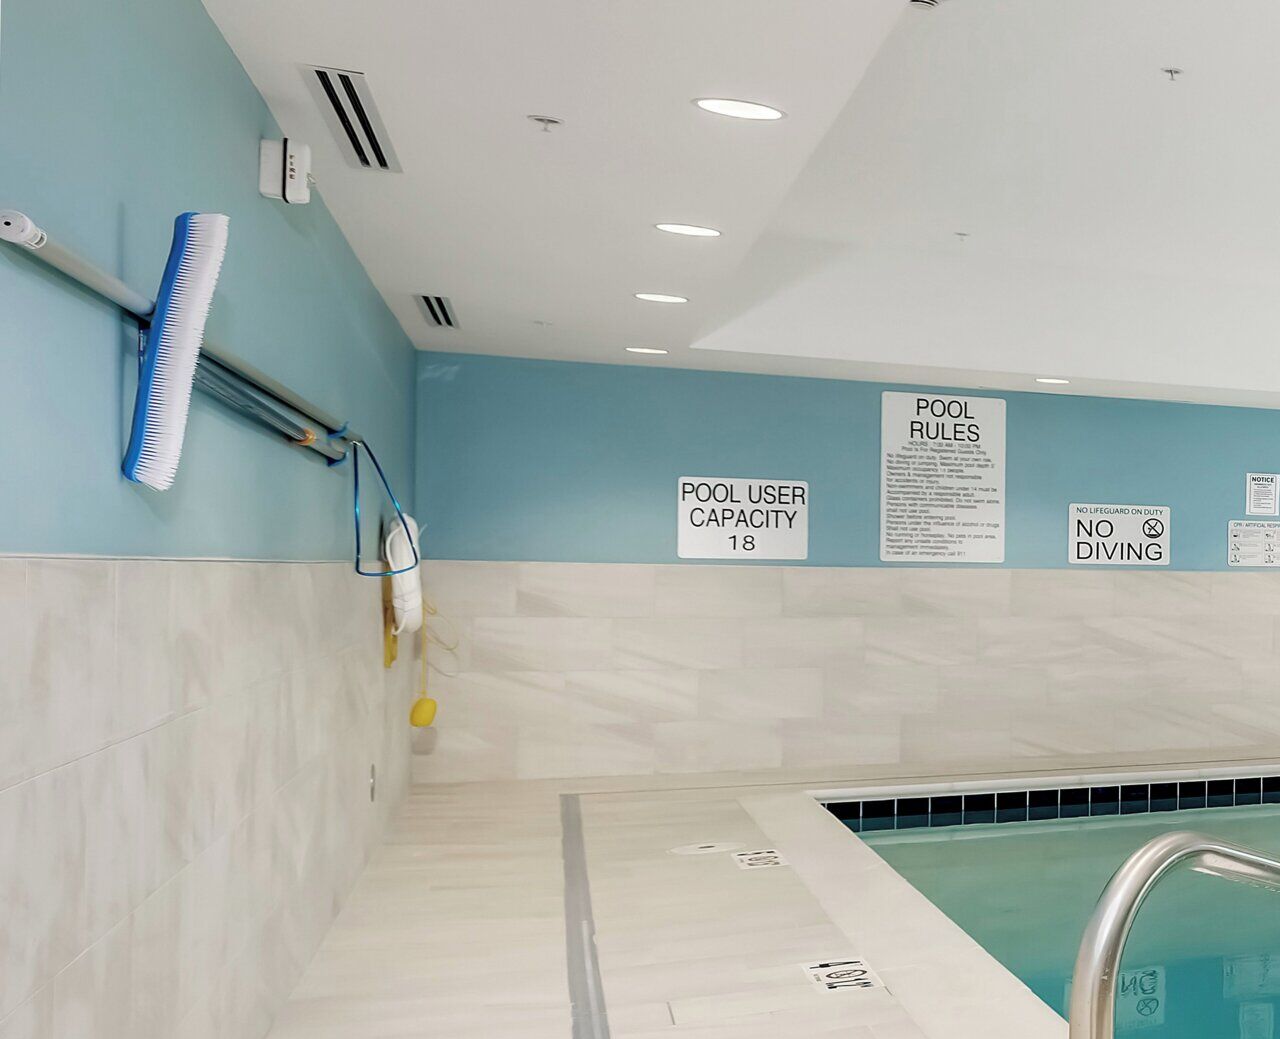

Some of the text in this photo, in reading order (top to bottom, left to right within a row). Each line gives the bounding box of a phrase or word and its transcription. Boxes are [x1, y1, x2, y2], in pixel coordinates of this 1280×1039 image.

[917, 398, 974, 419] POOL
[910, 421, 980, 442] RULES
[682, 483, 806, 505] POOL USER
[690, 508, 797, 528] CAPACITY
[1077, 519, 1113, 538] NO
[728, 535, 755, 551] 18
[1077, 542, 1162, 560] DIVING
